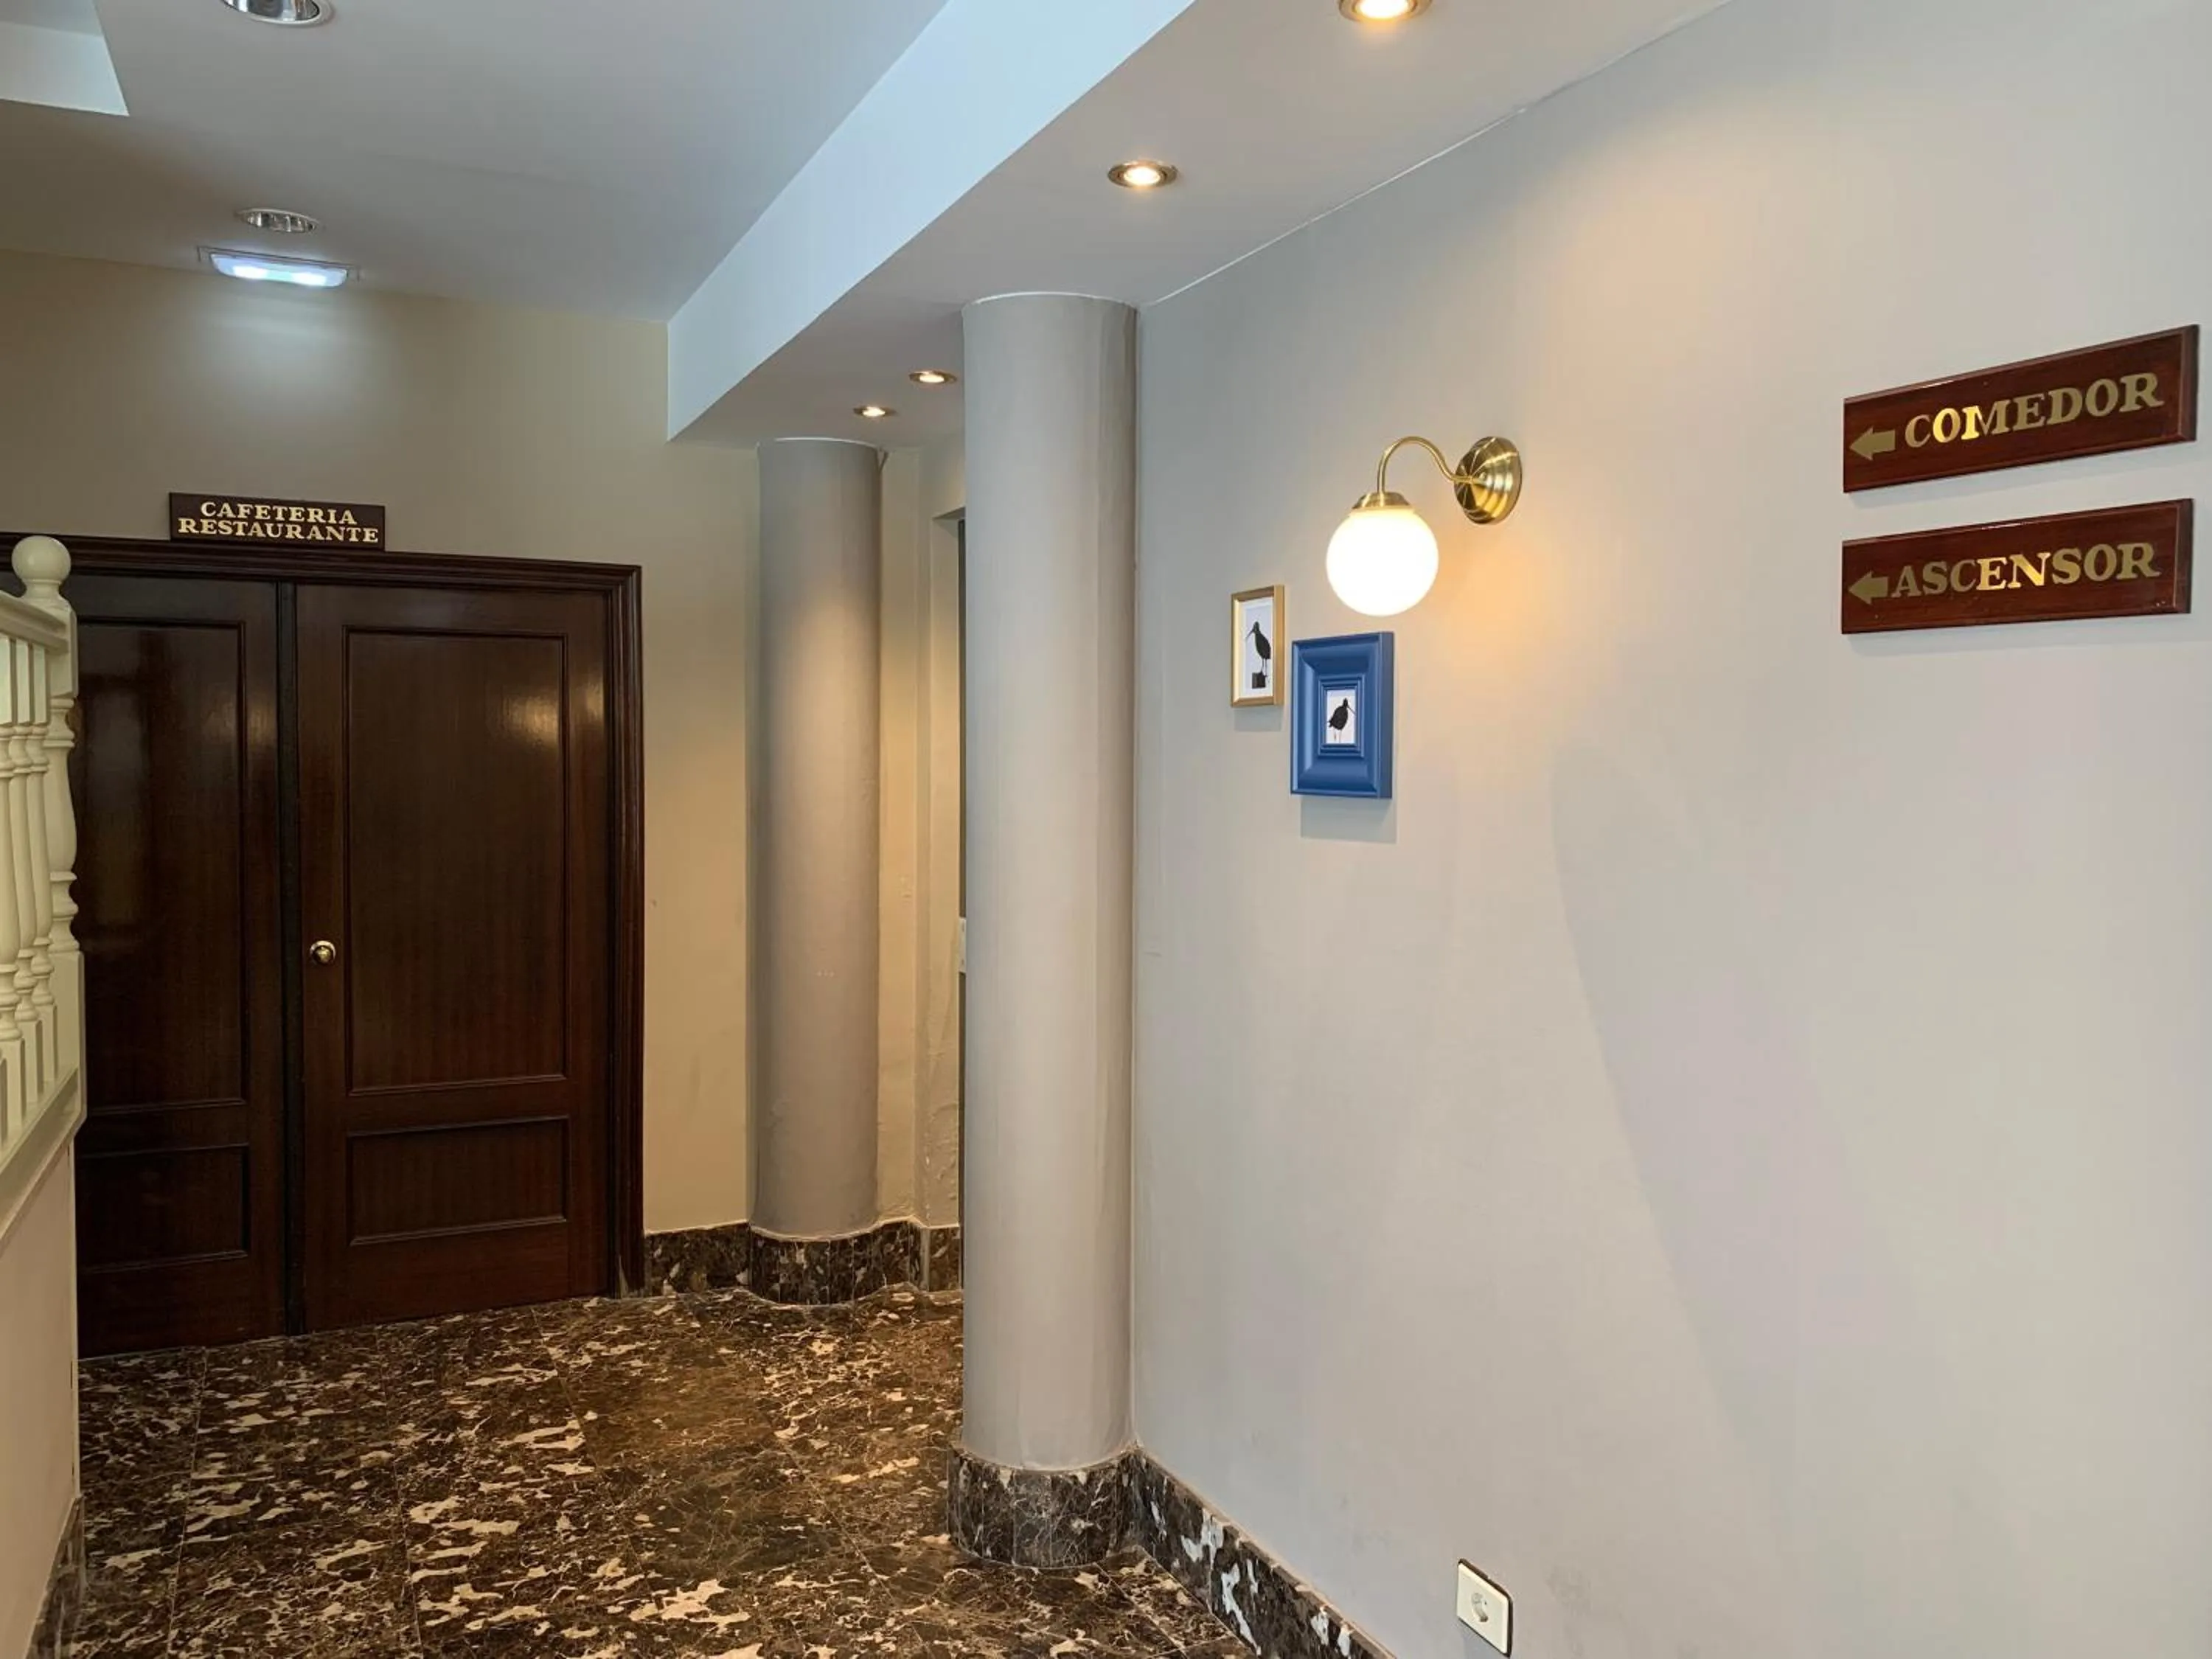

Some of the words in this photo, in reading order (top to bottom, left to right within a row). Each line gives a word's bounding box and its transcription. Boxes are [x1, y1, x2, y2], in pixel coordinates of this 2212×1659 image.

[1905, 372, 2164, 448] COMEDOR
[178, 518, 378, 543] RESTAURANTE
[201, 502, 357, 524] CAFETERIA
[1891, 543, 2160, 597] ASCENSOR
